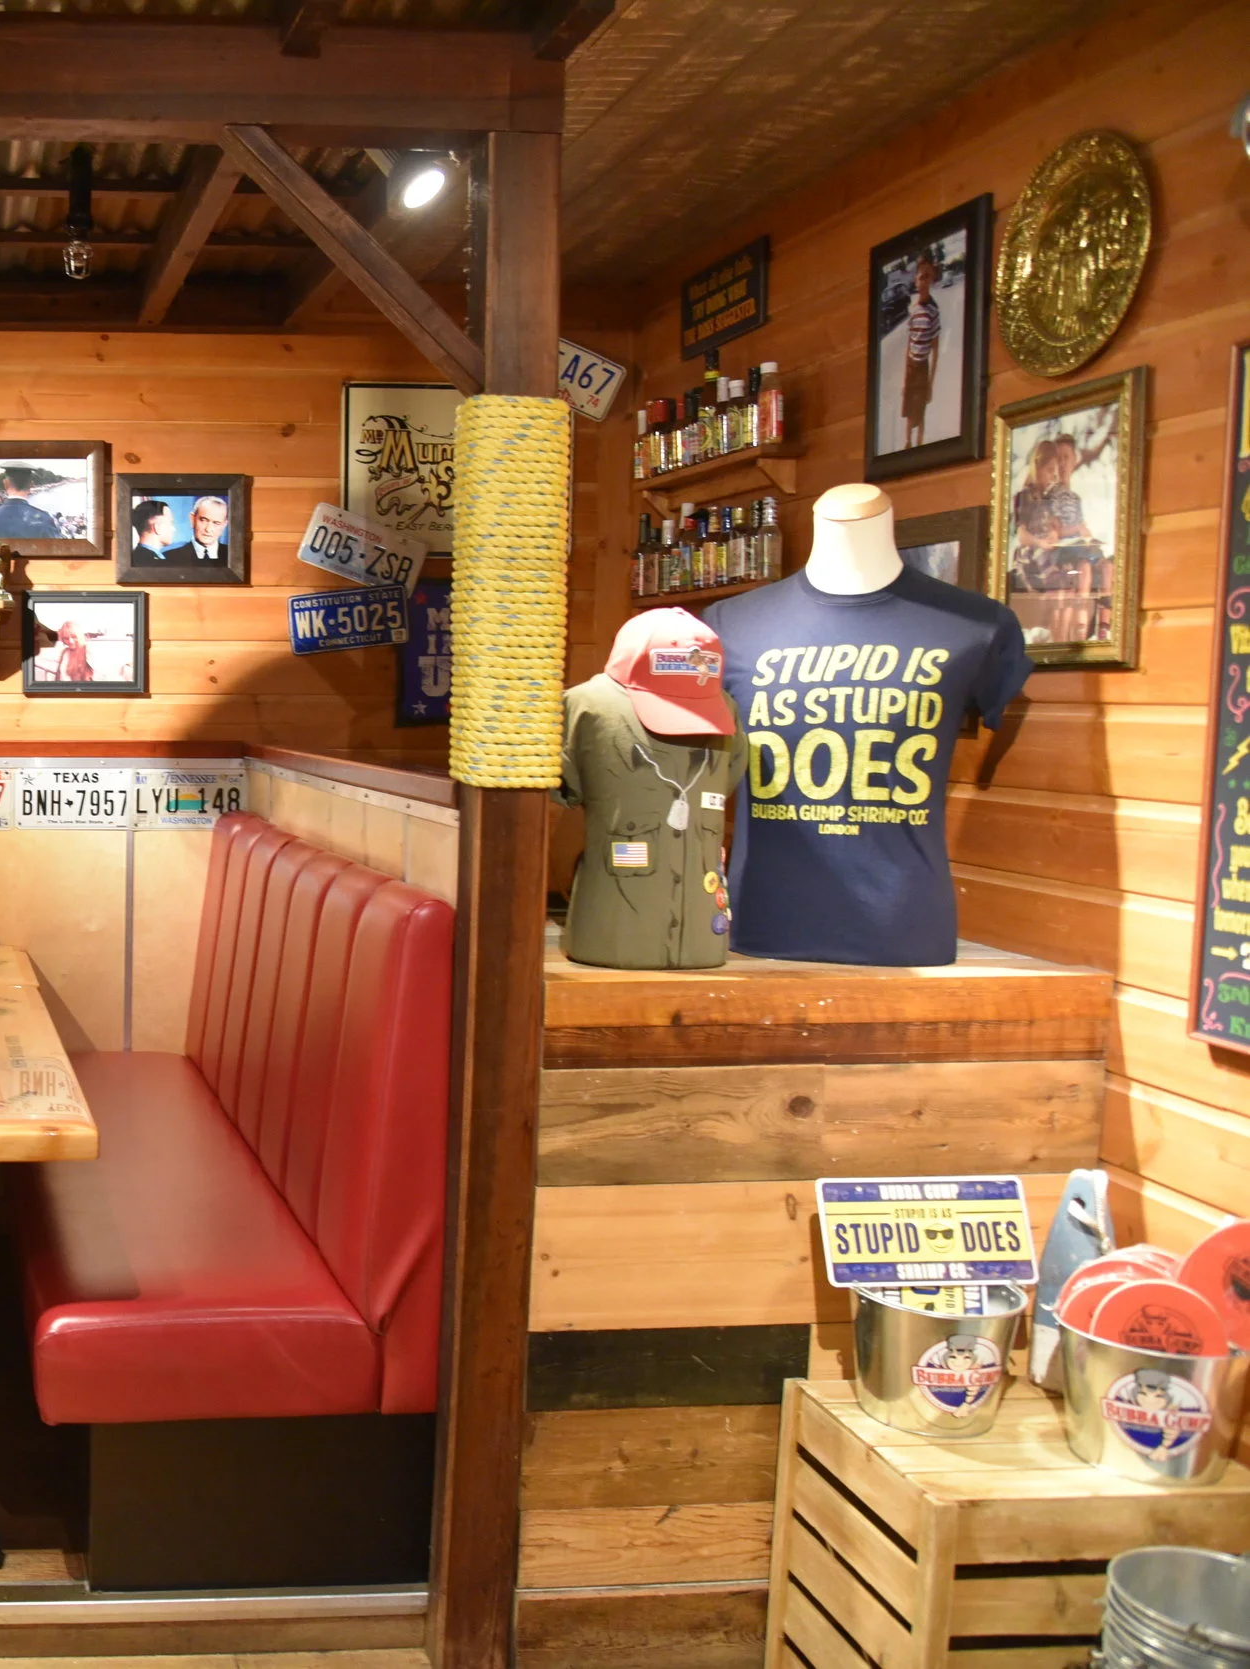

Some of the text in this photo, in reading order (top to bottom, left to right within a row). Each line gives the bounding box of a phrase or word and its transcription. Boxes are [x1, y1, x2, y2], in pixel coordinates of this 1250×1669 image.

[322, 514, 383, 544] WASHINGTON
[293, 589, 400, 610] CONSTITUTION STATE
[319, 632, 382, 647] CONNECTICUT
[751, 644, 949, 686] STUPID IS
[748, 687, 943, 729] AS STUPID
[748, 727, 938, 805] DOES
[53, 772, 99, 783] TEXAS
[163, 771, 217, 785] TENNESSEE
[76, 789, 127, 816] 7957
[136, 787, 240, 814] LYU 148
[161, 816, 213, 825] WASHINGTON
[751, 803, 798, 820] BUBBA
[800, 804, 845, 821] GUMP
[847, 806, 907, 824] SHRIMP
[818, 824, 860, 835] LONDON
[878, 1184, 959, 1200] BUBBA GUMP
[895, 1208, 951, 1218] STUPID IS AS
[835, 1221, 1021, 1254] STUPID DOES
[896, 1264, 946, 1280] SHRIMP
[917, 1369, 964, 1384] BUBBA
[1106, 1402, 1211, 1431] BUBBA GUMP
